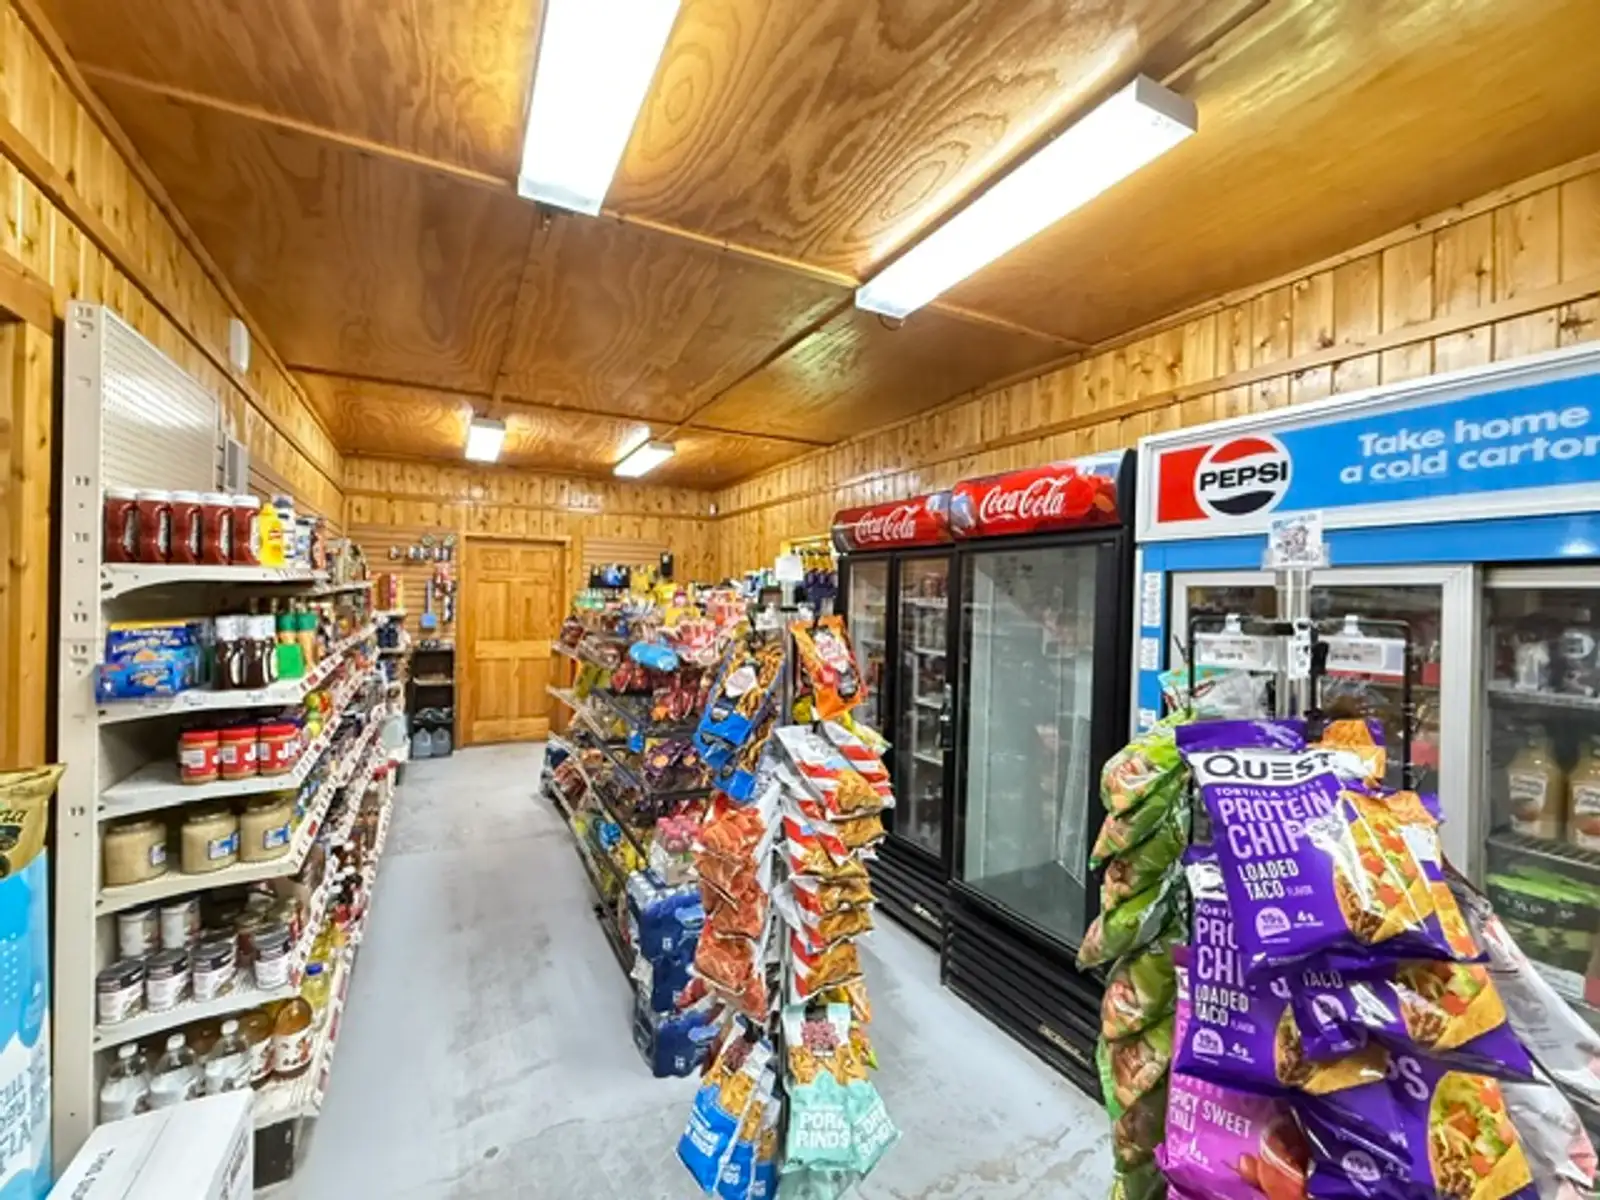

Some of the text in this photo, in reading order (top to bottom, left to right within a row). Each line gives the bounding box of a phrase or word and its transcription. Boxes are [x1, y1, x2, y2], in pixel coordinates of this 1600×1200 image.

[1358, 406, 1590, 457] Take home
[1200, 460, 1288, 491] PEPSI
[1340, 465, 1363, 484] a
[1369, 450, 1448, 480] cold
[1203, 752, 1336, 781] QUEST
[1214, 786, 1281, 798] TORTILLA
[1217, 788, 1335, 826] PROTEIN
[1227, 819, 1313, 860] CHIP
[1237, 857, 1300, 882] LOADED
[1243, 880, 1285, 901] TACO
[1302, 967, 1344, 989] TACO
[1195, 983, 1249, 1014] LOADED
[1195, 1001, 1229, 1027] TACO
[799, 1111, 849, 1130] PORK
[1201, 1099, 1252, 1139] SWEET
[795, 1129, 851, 1149] RINDS
